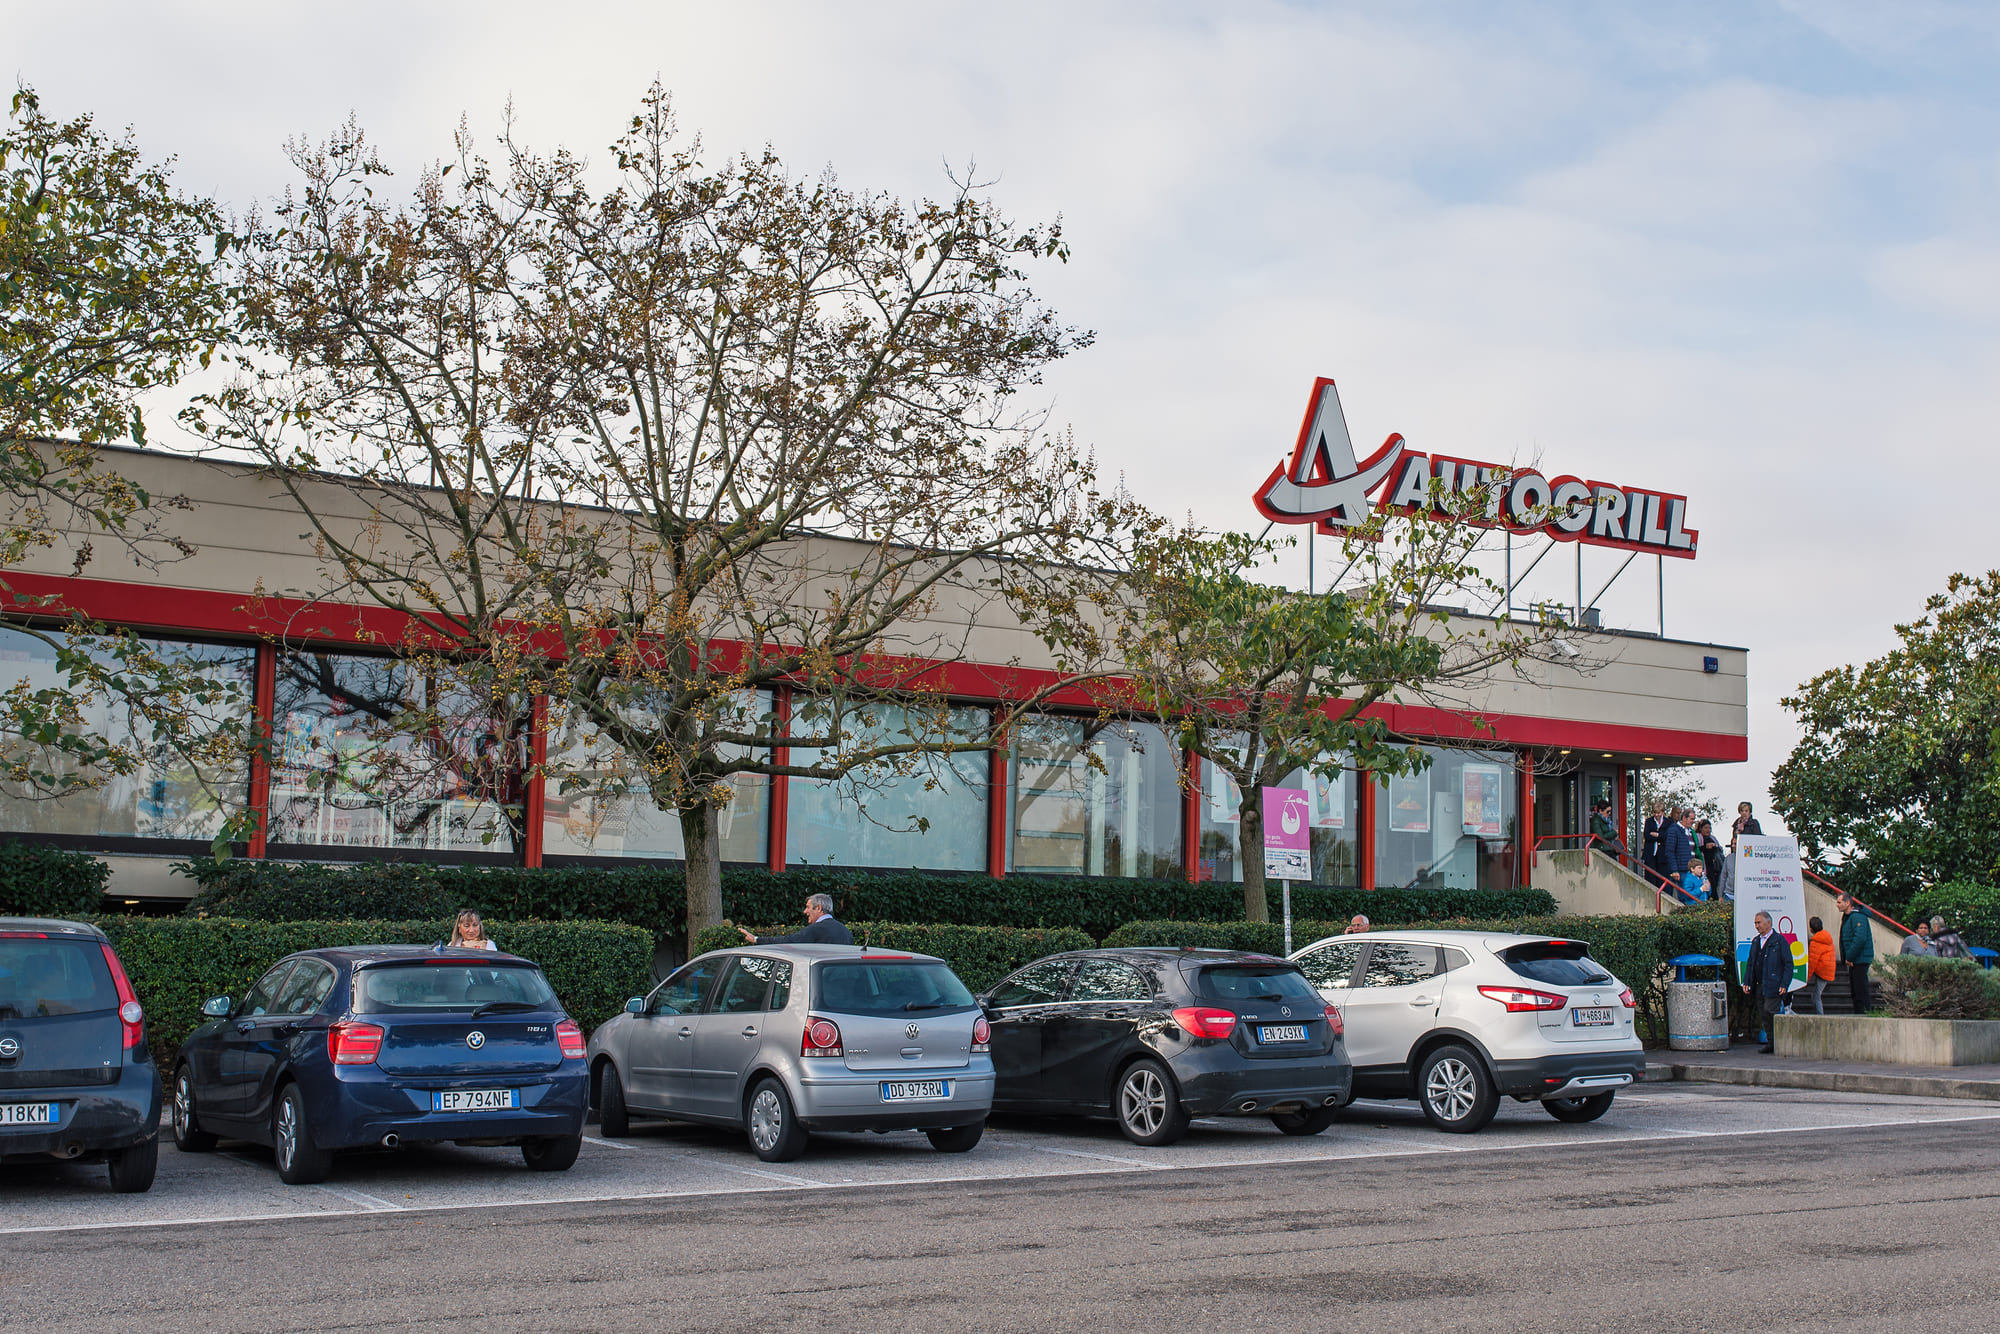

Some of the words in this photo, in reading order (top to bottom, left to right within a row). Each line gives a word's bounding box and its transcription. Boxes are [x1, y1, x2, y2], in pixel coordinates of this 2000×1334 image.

[1386, 452, 1695, 551] AUTOGRILL
[1264, 1027, 1276, 1040] EN
[890, 1083, 905, 1097] DD
[906, 1082, 942, 1097] 973RW
[443, 1092, 461, 1108] EP
[466, 1091, 510, 1107] 794NF
